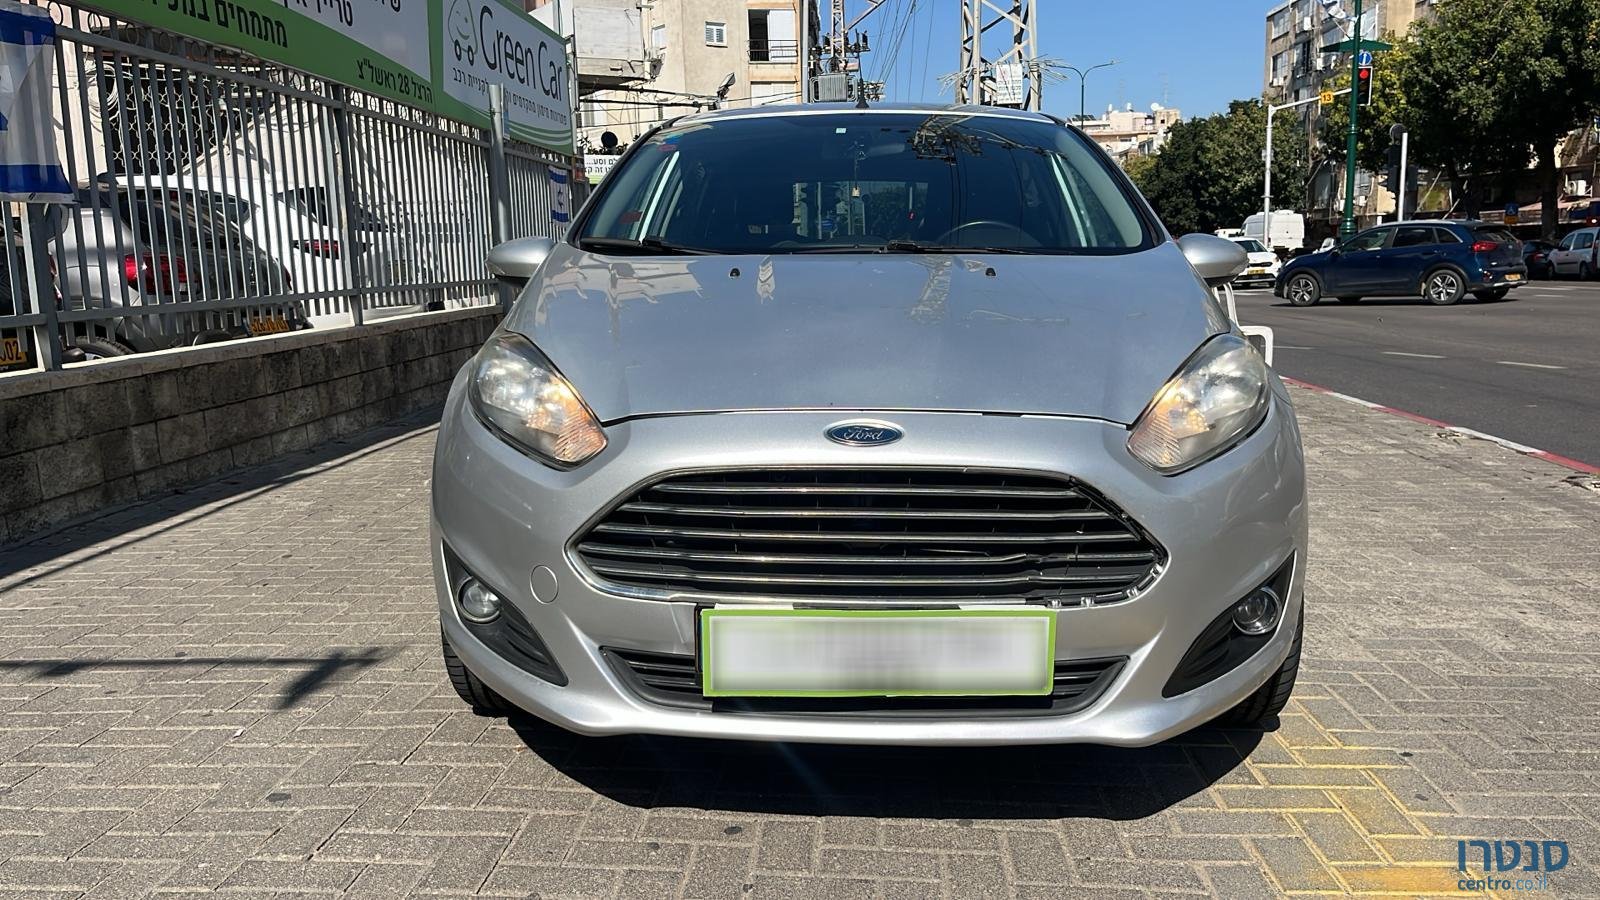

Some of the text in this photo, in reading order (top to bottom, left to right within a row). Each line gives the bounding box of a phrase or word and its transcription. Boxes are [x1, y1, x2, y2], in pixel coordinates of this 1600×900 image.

[215, 0, 288, 48] מתמחים
[480, 5, 563, 101] Green Car
[399, 72, 411, 95] 28
[453, 67, 467, 85] רכב
[411, 77, 433, 104] הרצל
[1323, 94, 1332, 102] 13
[843, 426, 884, 440] Ford
